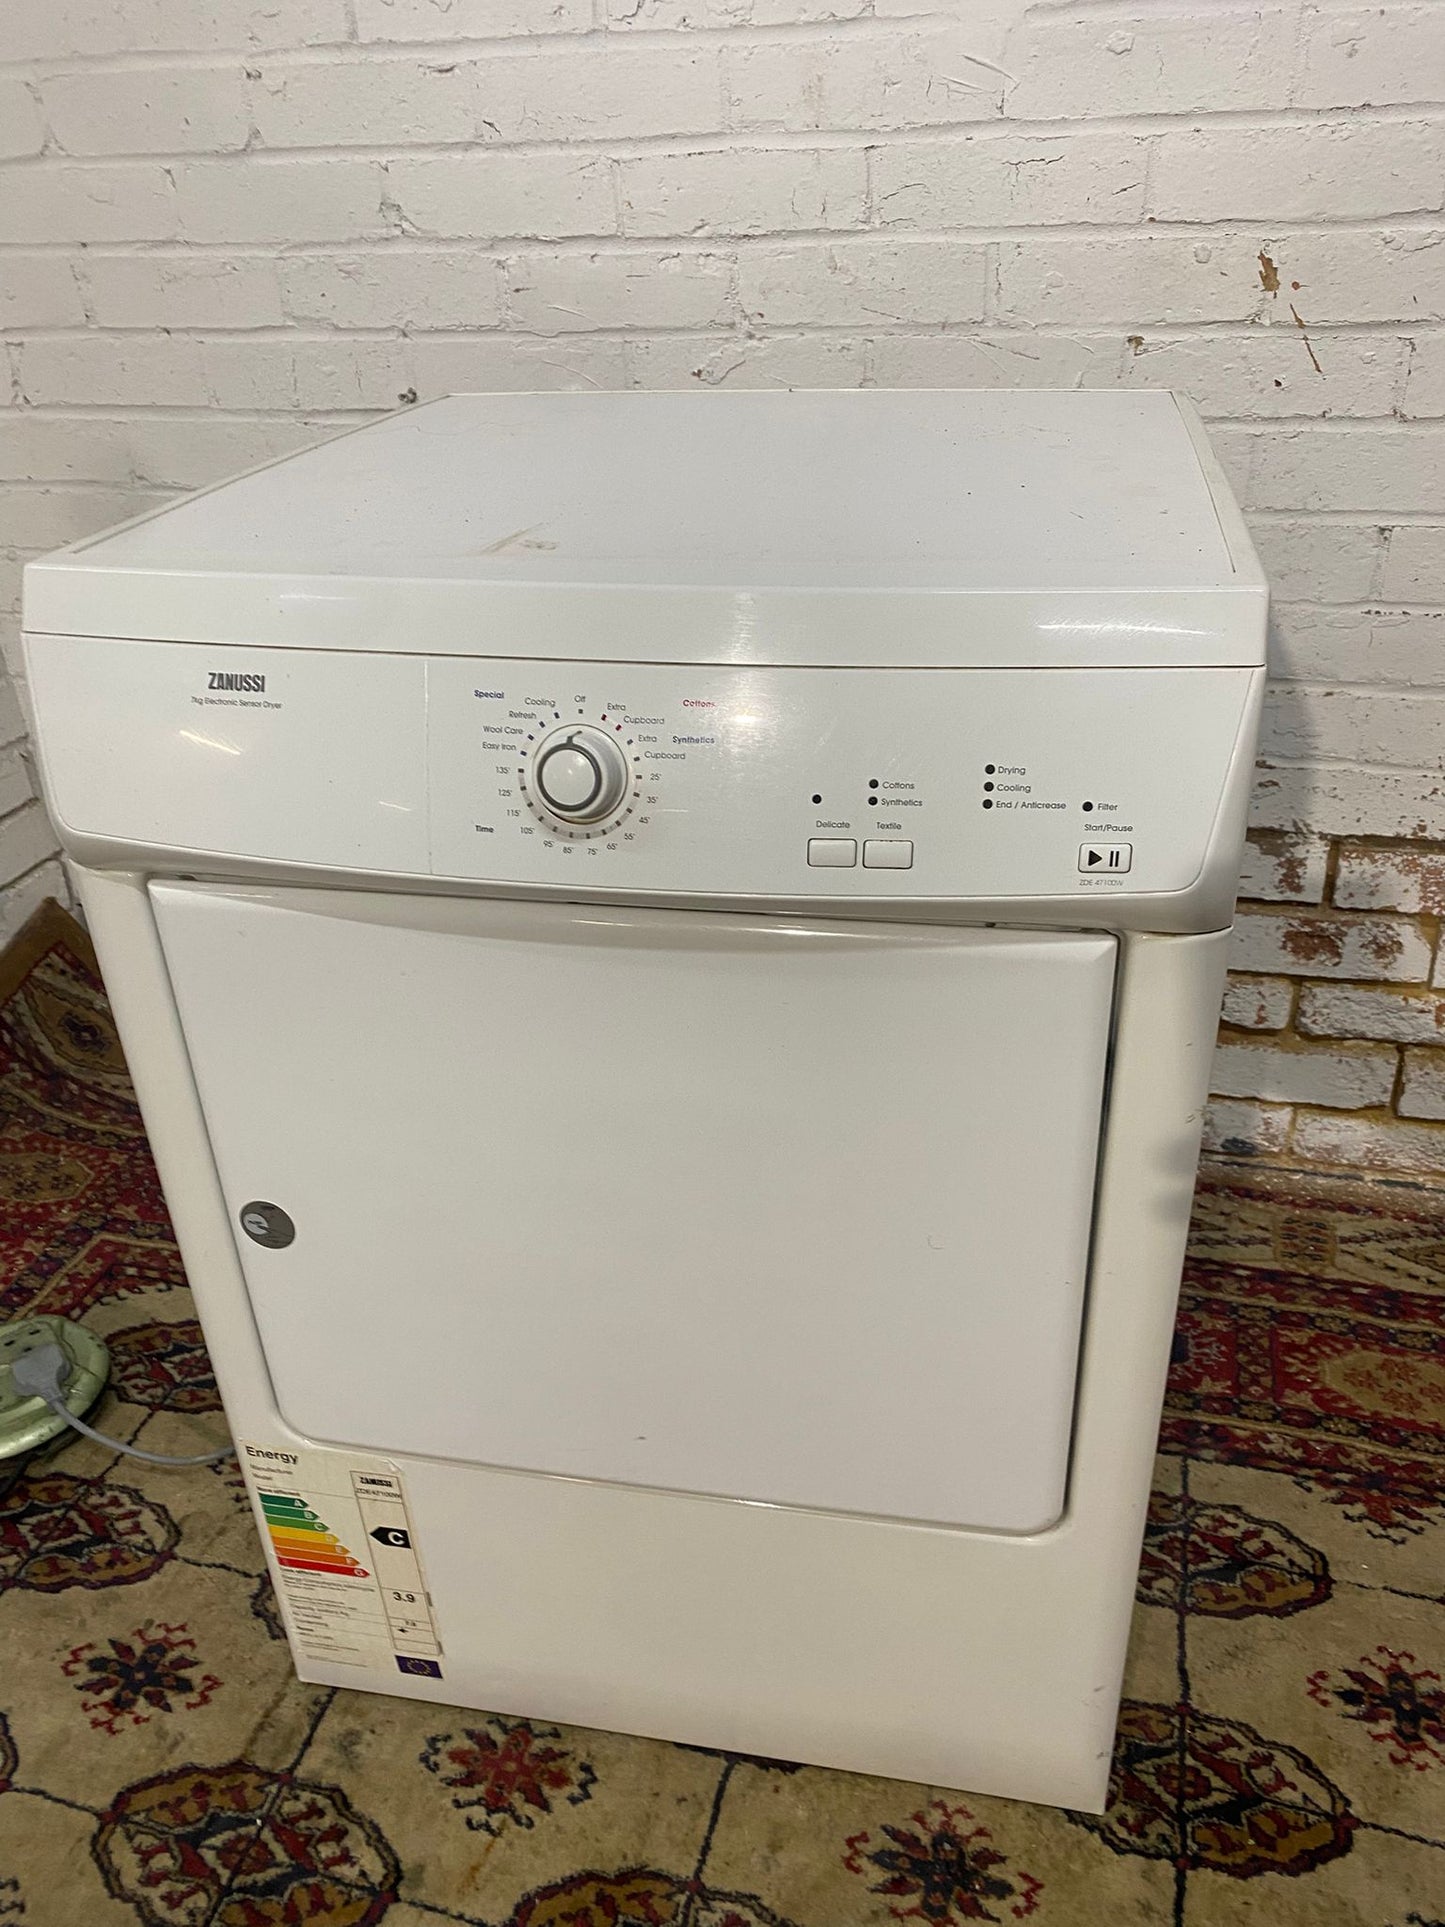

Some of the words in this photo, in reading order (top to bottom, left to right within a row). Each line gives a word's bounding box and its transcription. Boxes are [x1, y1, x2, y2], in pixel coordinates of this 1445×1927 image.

[208, 672, 265, 692] ZANUSSI
[474, 689, 504, 699] Special
[204, 697, 238, 707] Electronic
[239, 699, 262, 708] Sensor
[262, 701, 282, 710] Dryer
[524, 697, 556, 708] Cooling
[574, 695, 586, 703] Off
[607, 703, 626, 711] Extra
[508, 710, 537, 719] Refresh
[623, 715, 665, 725] Cupboard
[483, 725, 503, 733] Wool
[504, 726, 524, 735] Care
[638, 734, 657, 742] Extra
[672, 735, 715, 745] Synthetics
[482, 742, 499, 750] Easy
[501, 743, 517, 751] Iron
[644, 751, 686, 760] Cupboard
[998, 766, 1026, 776] Drying
[882, 781, 915, 790] Cottons
[997, 784, 1031, 793] Cooling
[881, 798, 923, 807] Synthetics
[996, 801, 1013, 809] End
[1020, 801, 1066, 810] Anticrease
[1097, 803, 1118, 811] Filter
[475, 825, 494, 833] Time
[816, 820, 850, 829] Delicate
[876, 822, 902, 830] Textile
[1084, 823, 1133, 832] Start/Pause
[245, 1446, 298, 1465] Energy
[388, 1531, 405, 1546] C
[393, 1591, 415, 1603] 3.9
